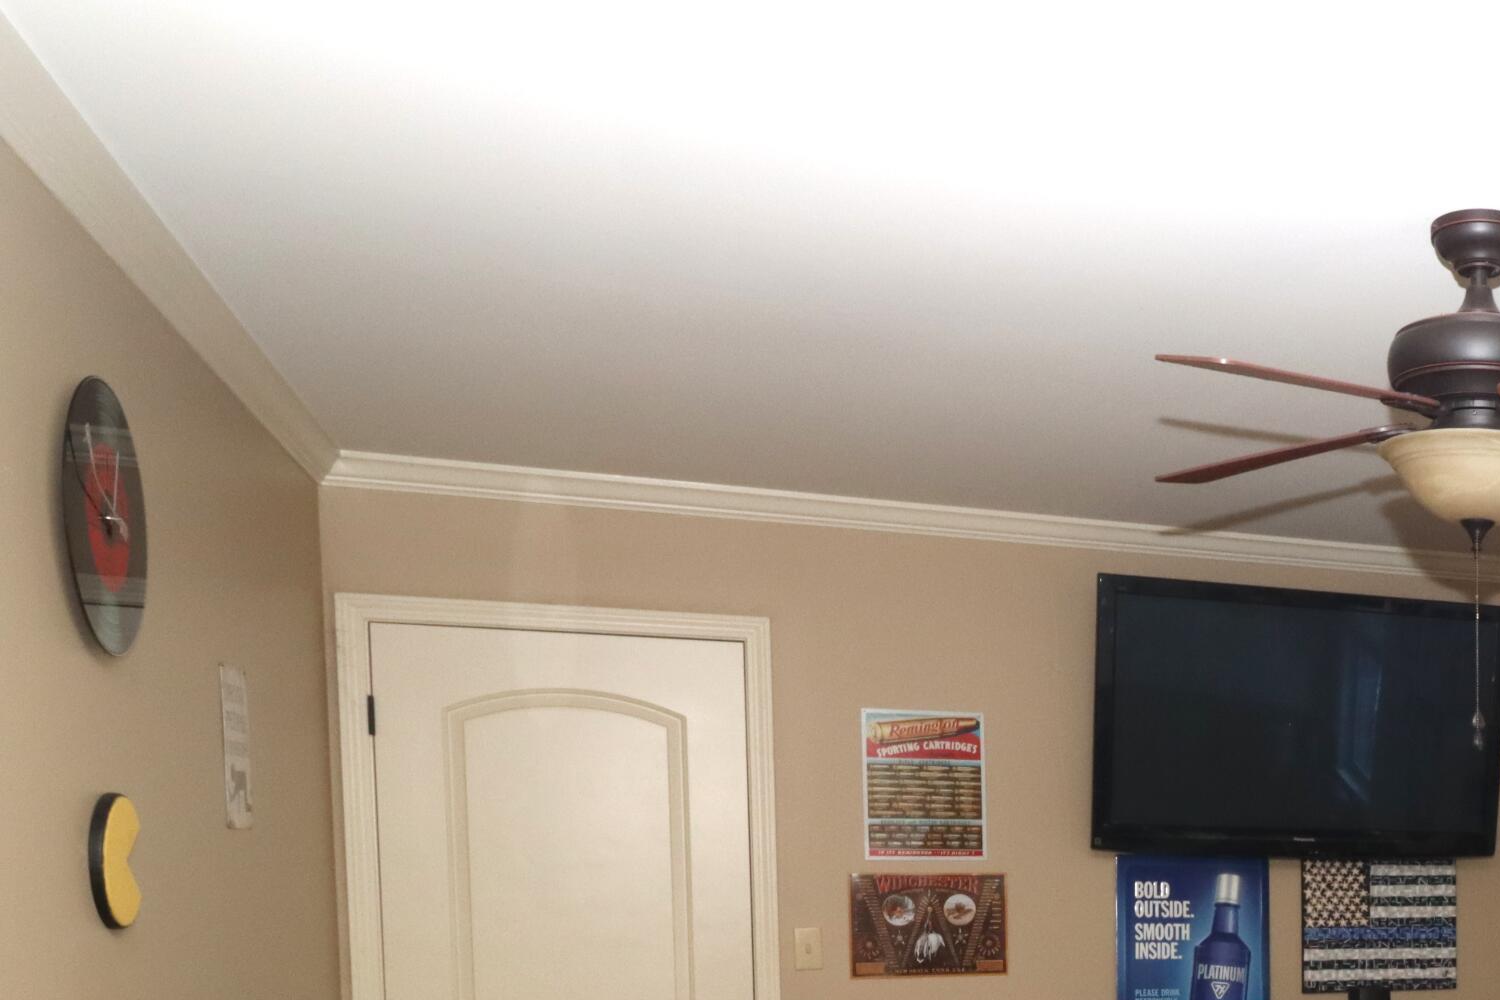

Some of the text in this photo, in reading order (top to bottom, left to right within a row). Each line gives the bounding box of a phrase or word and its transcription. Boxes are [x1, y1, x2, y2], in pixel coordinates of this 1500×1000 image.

[889, 718, 958, 738] Remington
[877, 740, 978, 757] SPORTING CARTRIDGES
[876, 873, 978, 893] WINCHESTER
[1134, 880, 1171, 899] BOLD
[1134, 900, 1195, 918] OUTSIDE.
[1134, 923, 1191, 941] SMOOTH
[1135, 942, 1183, 960] INSIDE.
[1197, 963, 1247, 982] PLATINUM
[1134, 988, 1159, 997] PLEASE
